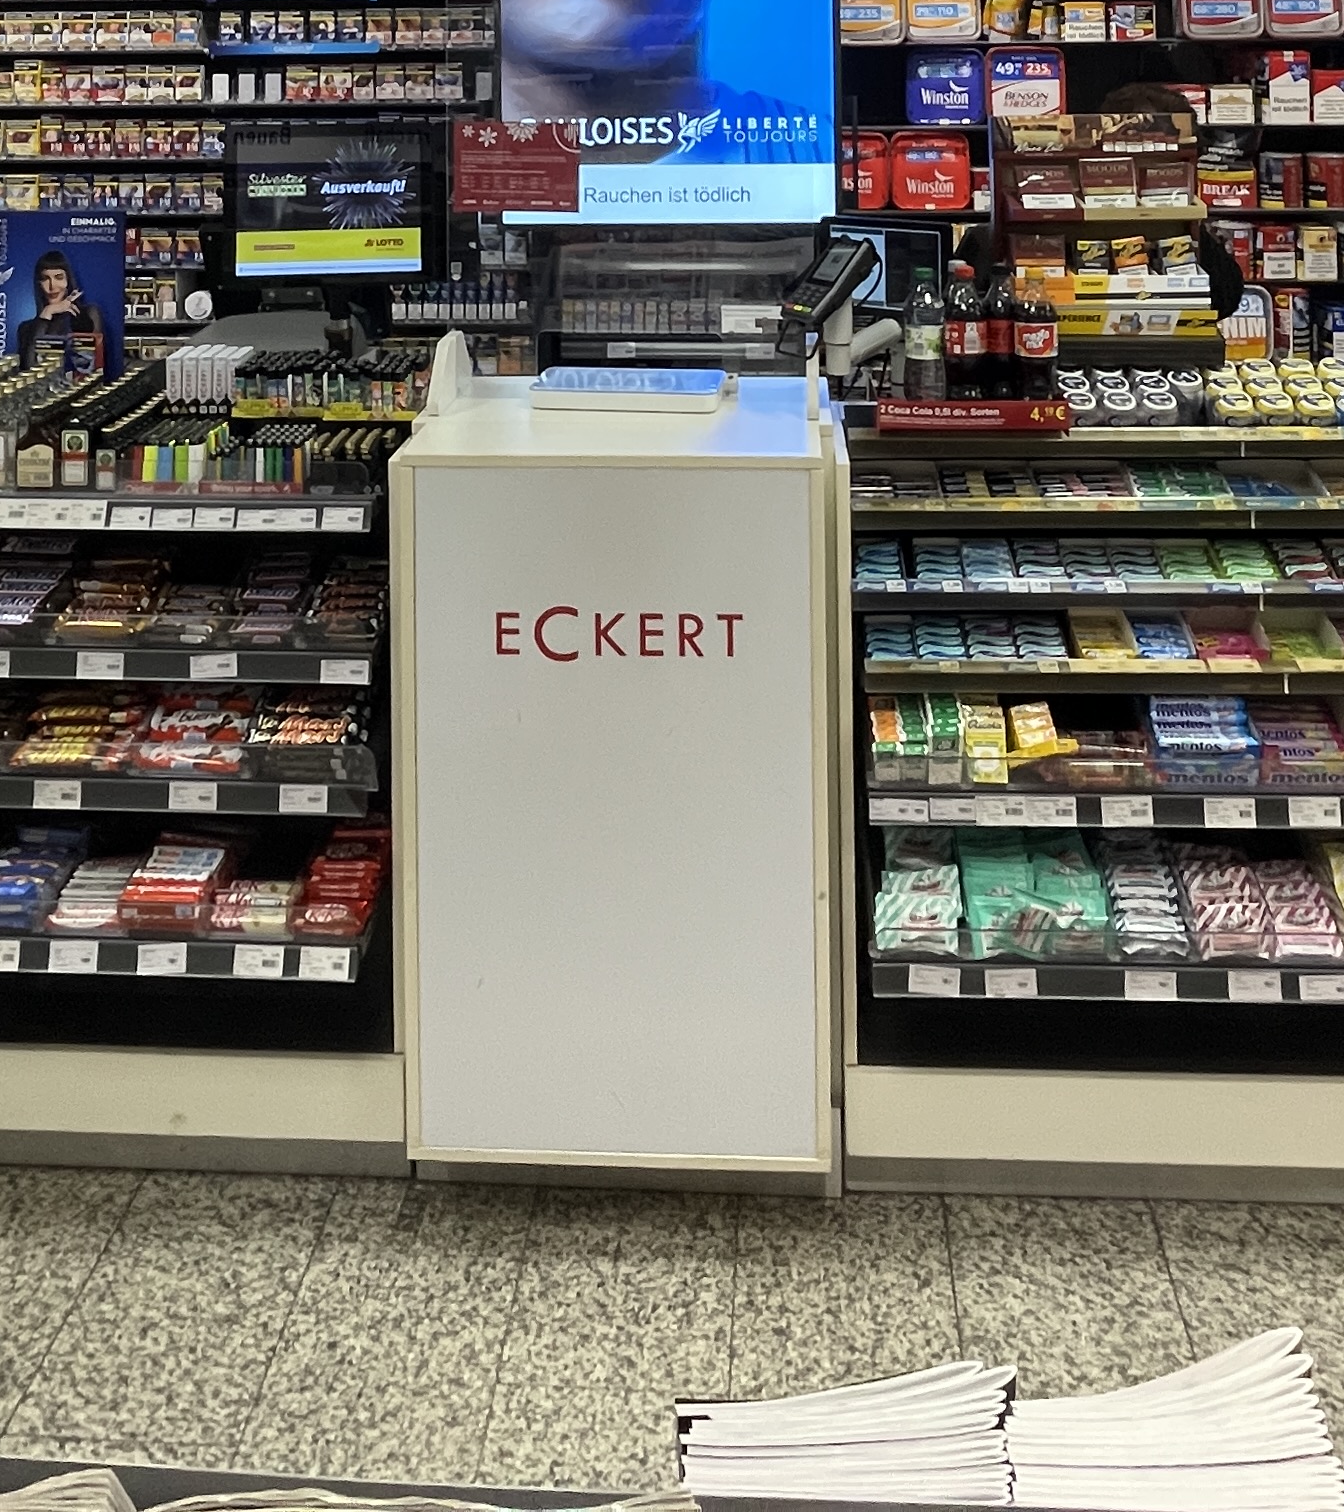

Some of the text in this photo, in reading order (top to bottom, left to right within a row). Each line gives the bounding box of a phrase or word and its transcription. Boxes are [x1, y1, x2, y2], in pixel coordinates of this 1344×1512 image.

[921, 88, 969, 105] Winston
[579, 117, 674, 147] LOISES
[725, 130, 818, 143] TOUJOURS
[249, 173, 306, 185] Silvester
[321, 179, 406, 196] Ausverkauft!
[906, 177, 954, 194] Winston
[584, 186, 750, 203] Rauchen ist tödlich
[1203, 184, 1250, 195] BREAK
[376, 238, 404, 247] LOTTO
[970, 408, 1000, 416] Sorten
[495, 605, 743, 662] ECKERT
